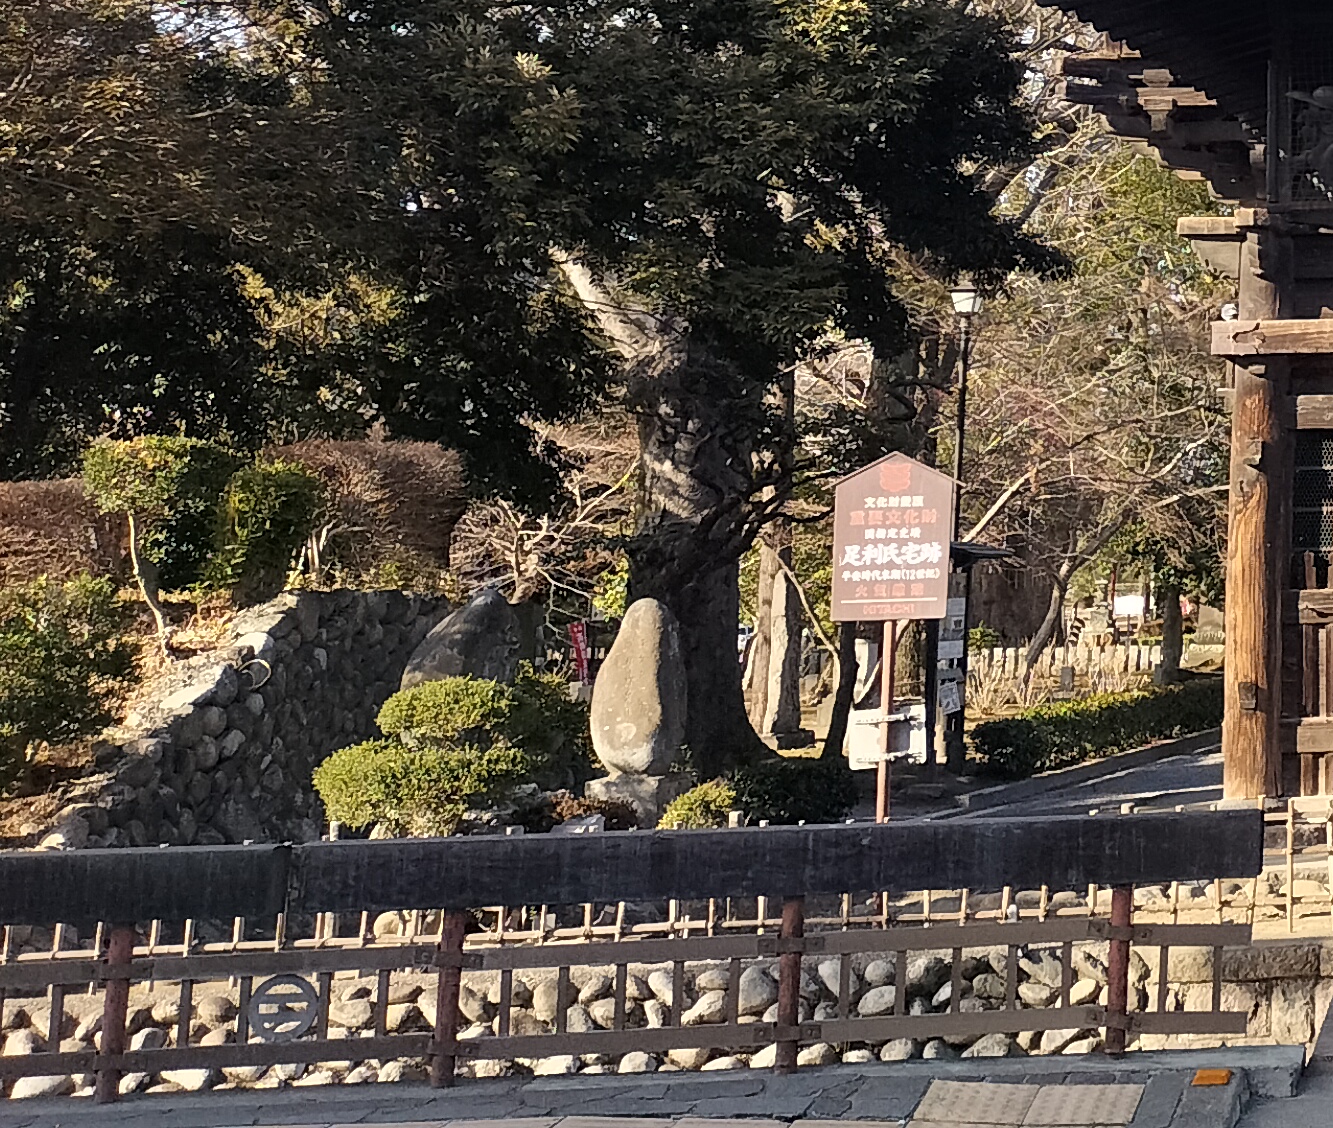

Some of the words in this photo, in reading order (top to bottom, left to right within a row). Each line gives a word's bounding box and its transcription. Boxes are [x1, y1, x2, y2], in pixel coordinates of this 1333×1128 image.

[841, 541, 943, 566] 足利氏宅跡
